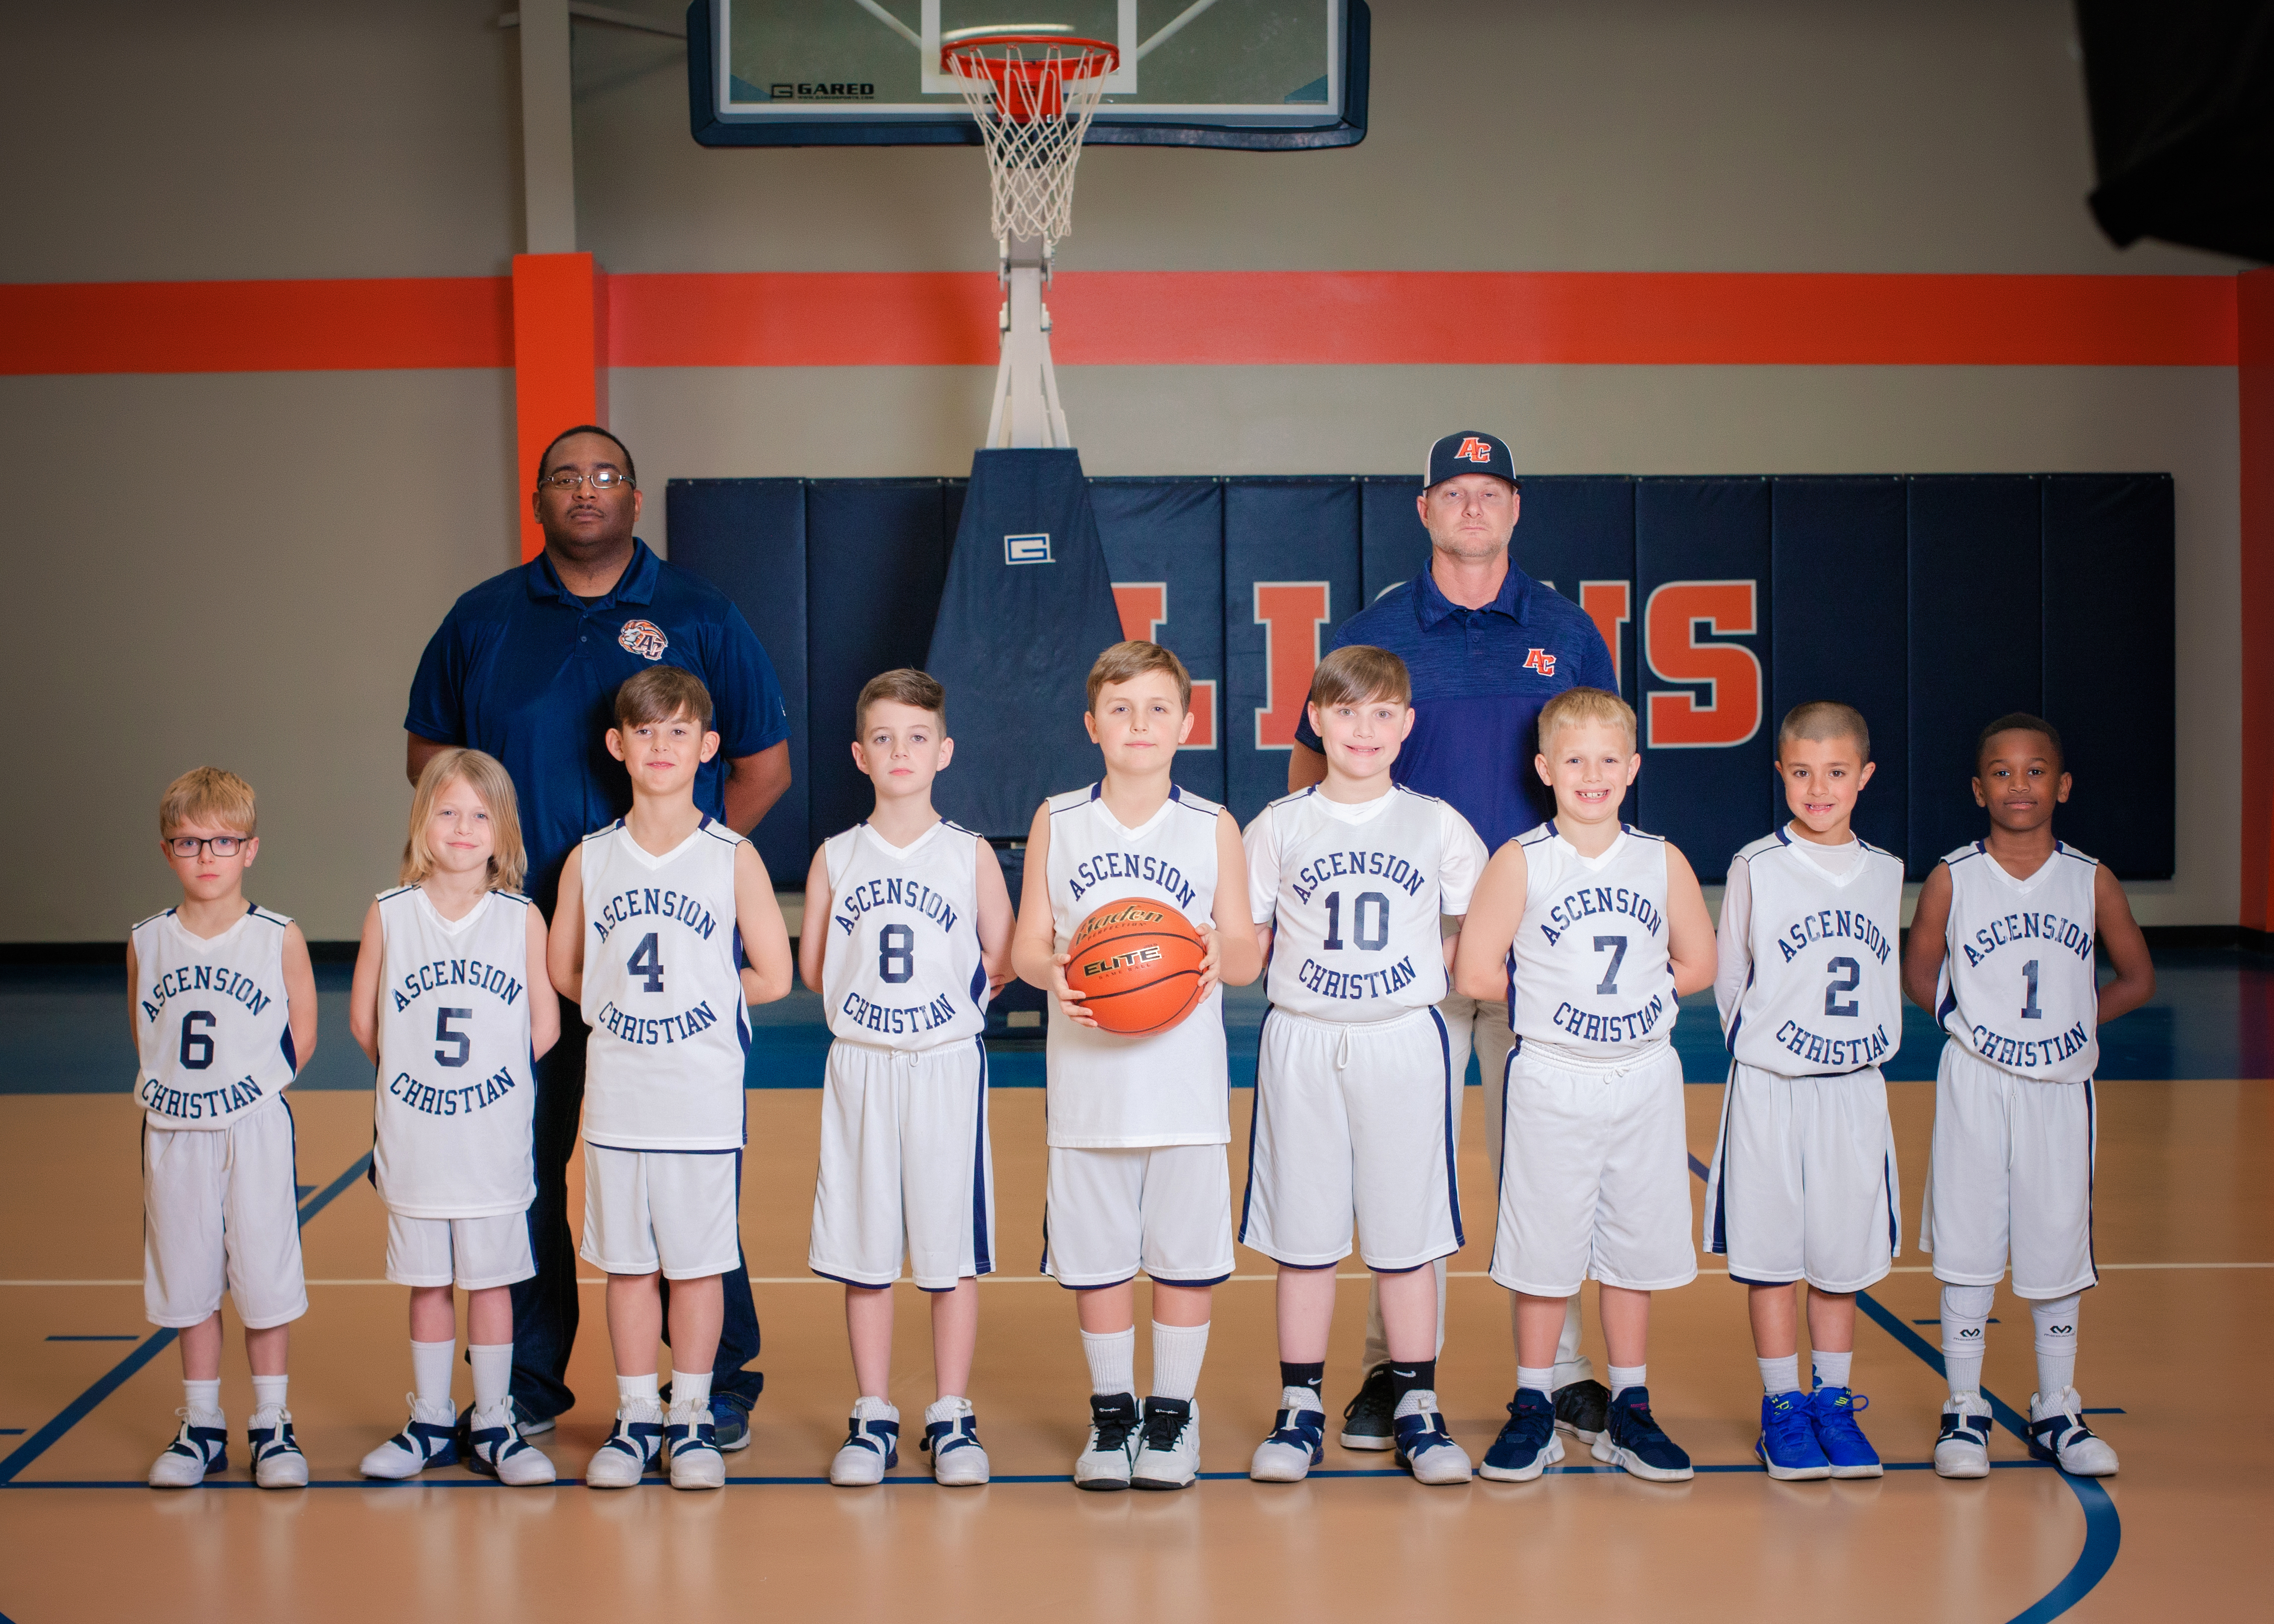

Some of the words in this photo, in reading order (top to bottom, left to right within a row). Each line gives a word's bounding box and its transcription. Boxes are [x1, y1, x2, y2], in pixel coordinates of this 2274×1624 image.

[798, 83, 874, 95] GARED
[1454, 437, 1491, 463] AC
[1522, 648, 1557, 677] AC
[1069, 853, 1196, 910] ASCENSION
[1293, 851, 1424, 905] ASCENSION
[594, 889, 716, 944] ASCENSION
[835, 878, 957, 936] ASCENSION
[1075, 904, 1164, 948] Baden
[1324, 891, 1390, 951] 10
[1540, 887, 1661, 947] ASCENSION
[627, 933, 664, 993] 4
[879, 924, 914, 983] 8
[1083, 946, 1162, 978] ELITE
[1778, 910, 1891, 965] ASCENSION
[1963, 913, 2092, 968] ASCENSION
[391, 959, 523, 1012] ASCENSION
[1099, 971, 1122, 979] GAME
[1128, 963, 1151, 972] BALL
[1299, 955, 1416, 999] CHRISTIAN
[1593, 936, 1627, 995] 7
[1824, 956, 1860, 1017] 2
[2021, 960, 2042, 1019] 1
[142, 965, 271, 1023] ASCENSION
[843, 993, 956, 1034] CHRISTIAN
[1553, 994, 1662, 1042] CHRISTIAN
[180, 1011, 216, 1069] 6
[434, 1007, 473, 1067] 5
[599, 1000, 717, 1045] CHRISTIAN
[1776, 1020, 1890, 1065] CHRISTIAN
[1973, 1021, 2088, 1067] CHRISTIAN
[142, 1075, 263, 1119] CHRISTIAN
[390, 1066, 515, 1115] CHRISTIAN
